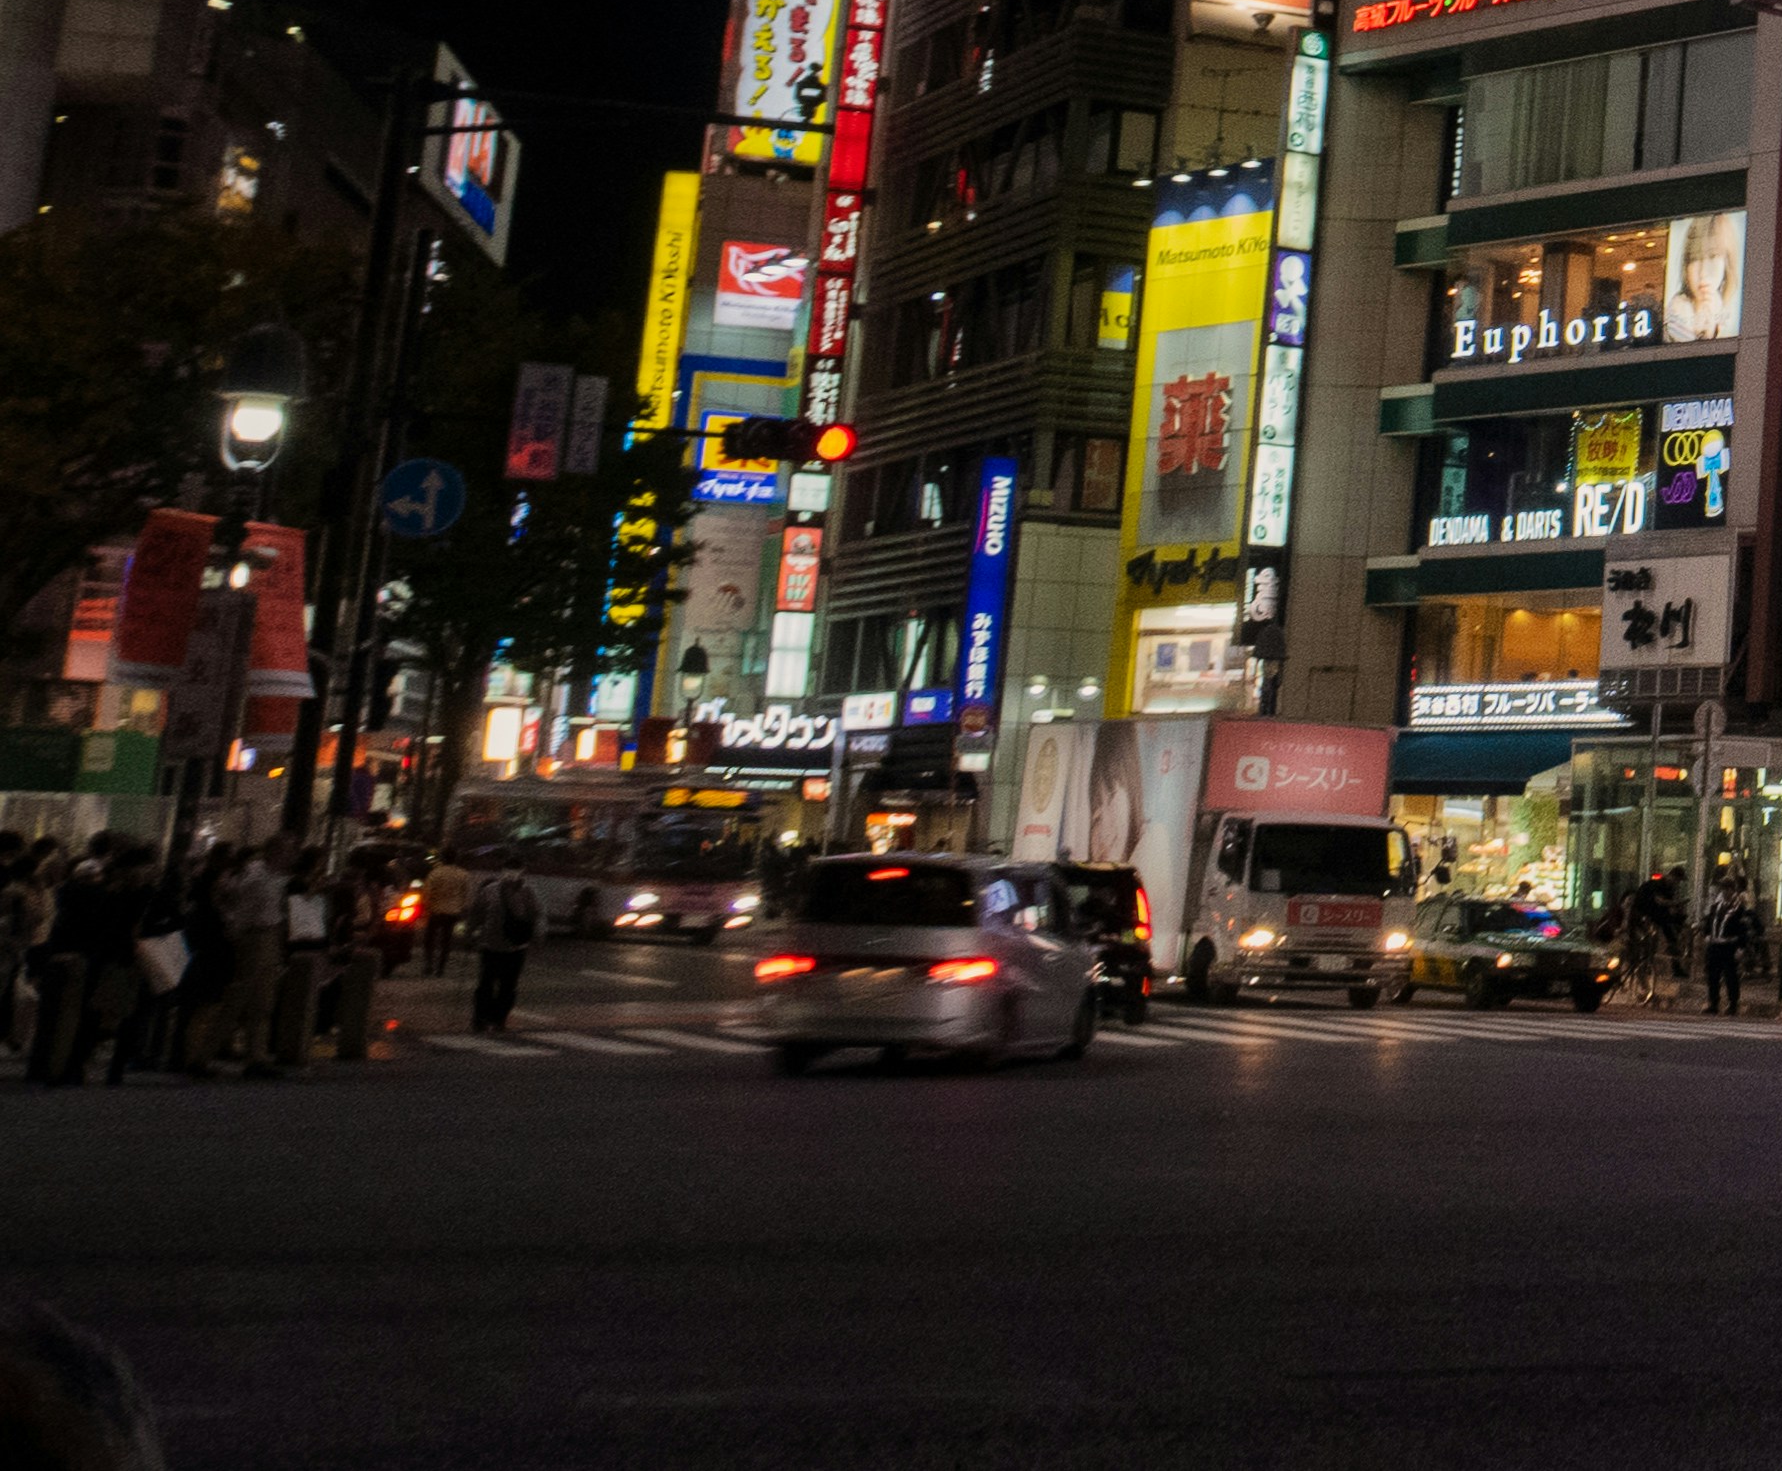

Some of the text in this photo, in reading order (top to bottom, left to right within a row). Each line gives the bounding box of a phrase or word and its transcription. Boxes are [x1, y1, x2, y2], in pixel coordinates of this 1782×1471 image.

[1156, 235, 1270, 267] Matsumoto KiYo
[1451, 304, 1653, 363] Euphoria
[984, 475, 1013, 557] MIZUHO
[1428, 509, 1563, 546] DENDAMA & DARTS
[1483, 689, 1600, 716] フルーツパーラー
[1275, 764, 1363, 792] シースリー
